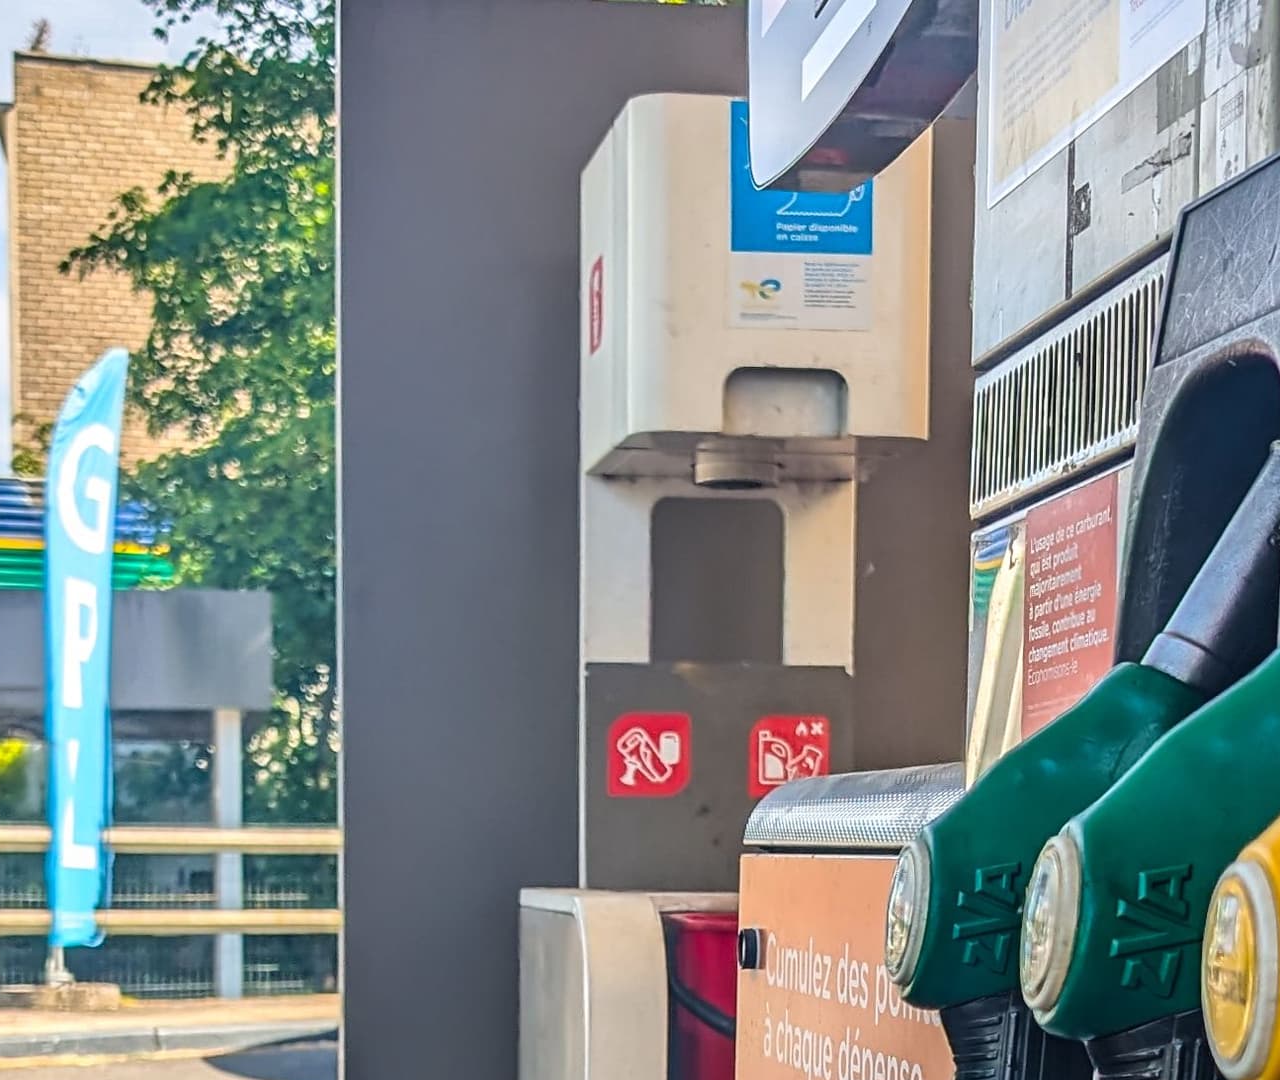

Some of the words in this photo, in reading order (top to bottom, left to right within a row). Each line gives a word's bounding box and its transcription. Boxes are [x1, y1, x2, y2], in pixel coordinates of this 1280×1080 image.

[776, 222, 807, 232] Papier
[808, 223, 859, 233] disponible
[1030, 529, 1055, 554] L'usage
[1055, 528, 1065, 544] de
[1066, 525, 1075, 541] ce
[1075, 505, 1113, 536] carburant,
[1030, 556, 1041, 578] qui
[1041, 551, 1052, 571] est
[1052, 543, 1078, 569] produit
[1029, 565, 1082, 599] majoritairement
[1034, 594, 1053, 621] partir
[1074, 579, 1102, 605] énergie
[1052, 610, 1086, 636] contribue
[1086, 607, 1096, 624] au
[57, 421, 115, 871] GPL
[1028, 635, 1070, 664] changement
[1070, 625, 1110, 652] climatique.
[765, 931, 833, 1000] Cumulez
[836, 942, 869, 1009] des
[763, 1001, 772, 1058] à
